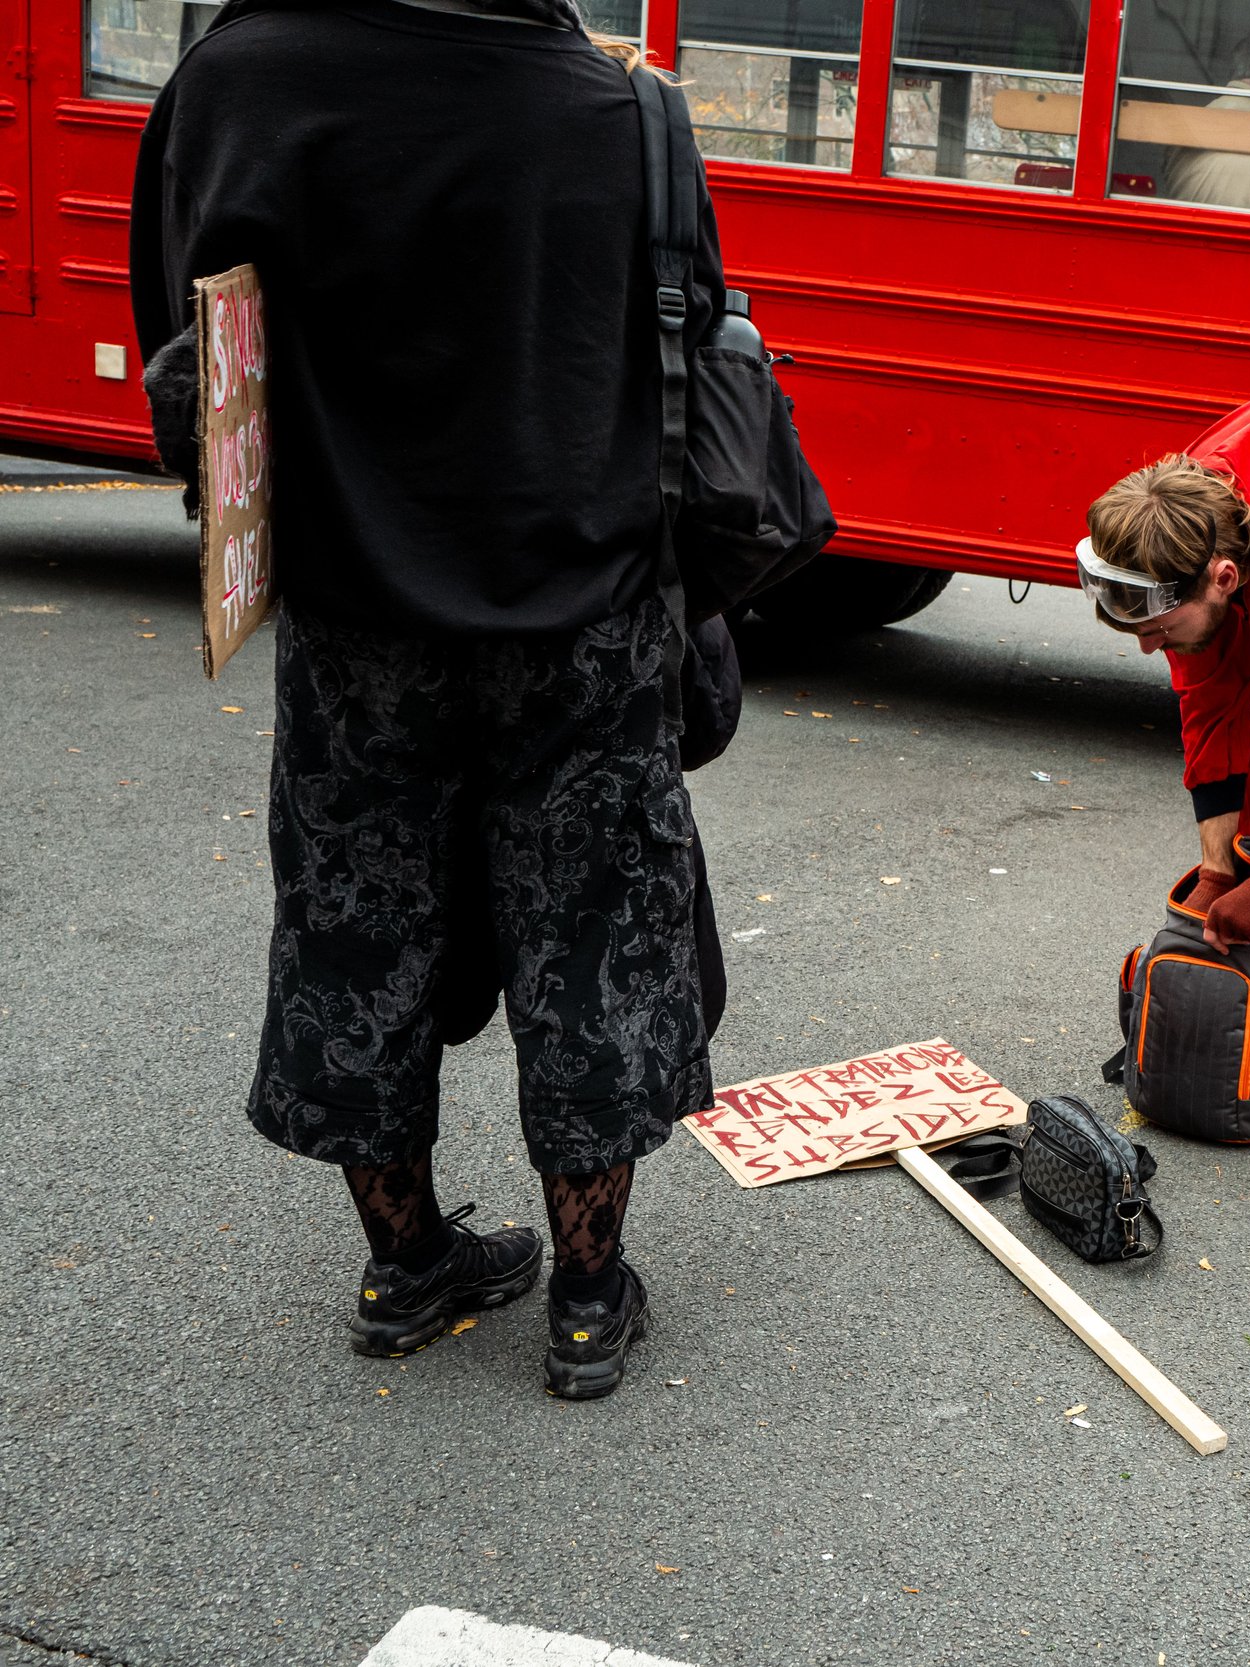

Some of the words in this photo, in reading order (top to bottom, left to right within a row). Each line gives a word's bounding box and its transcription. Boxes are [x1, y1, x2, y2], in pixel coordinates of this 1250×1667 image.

[786, 1042, 969, 1098] FRATRICIDE
[708, 1083, 934, 1158] RENDEZ
[934, 1070, 1003, 1094] LES
